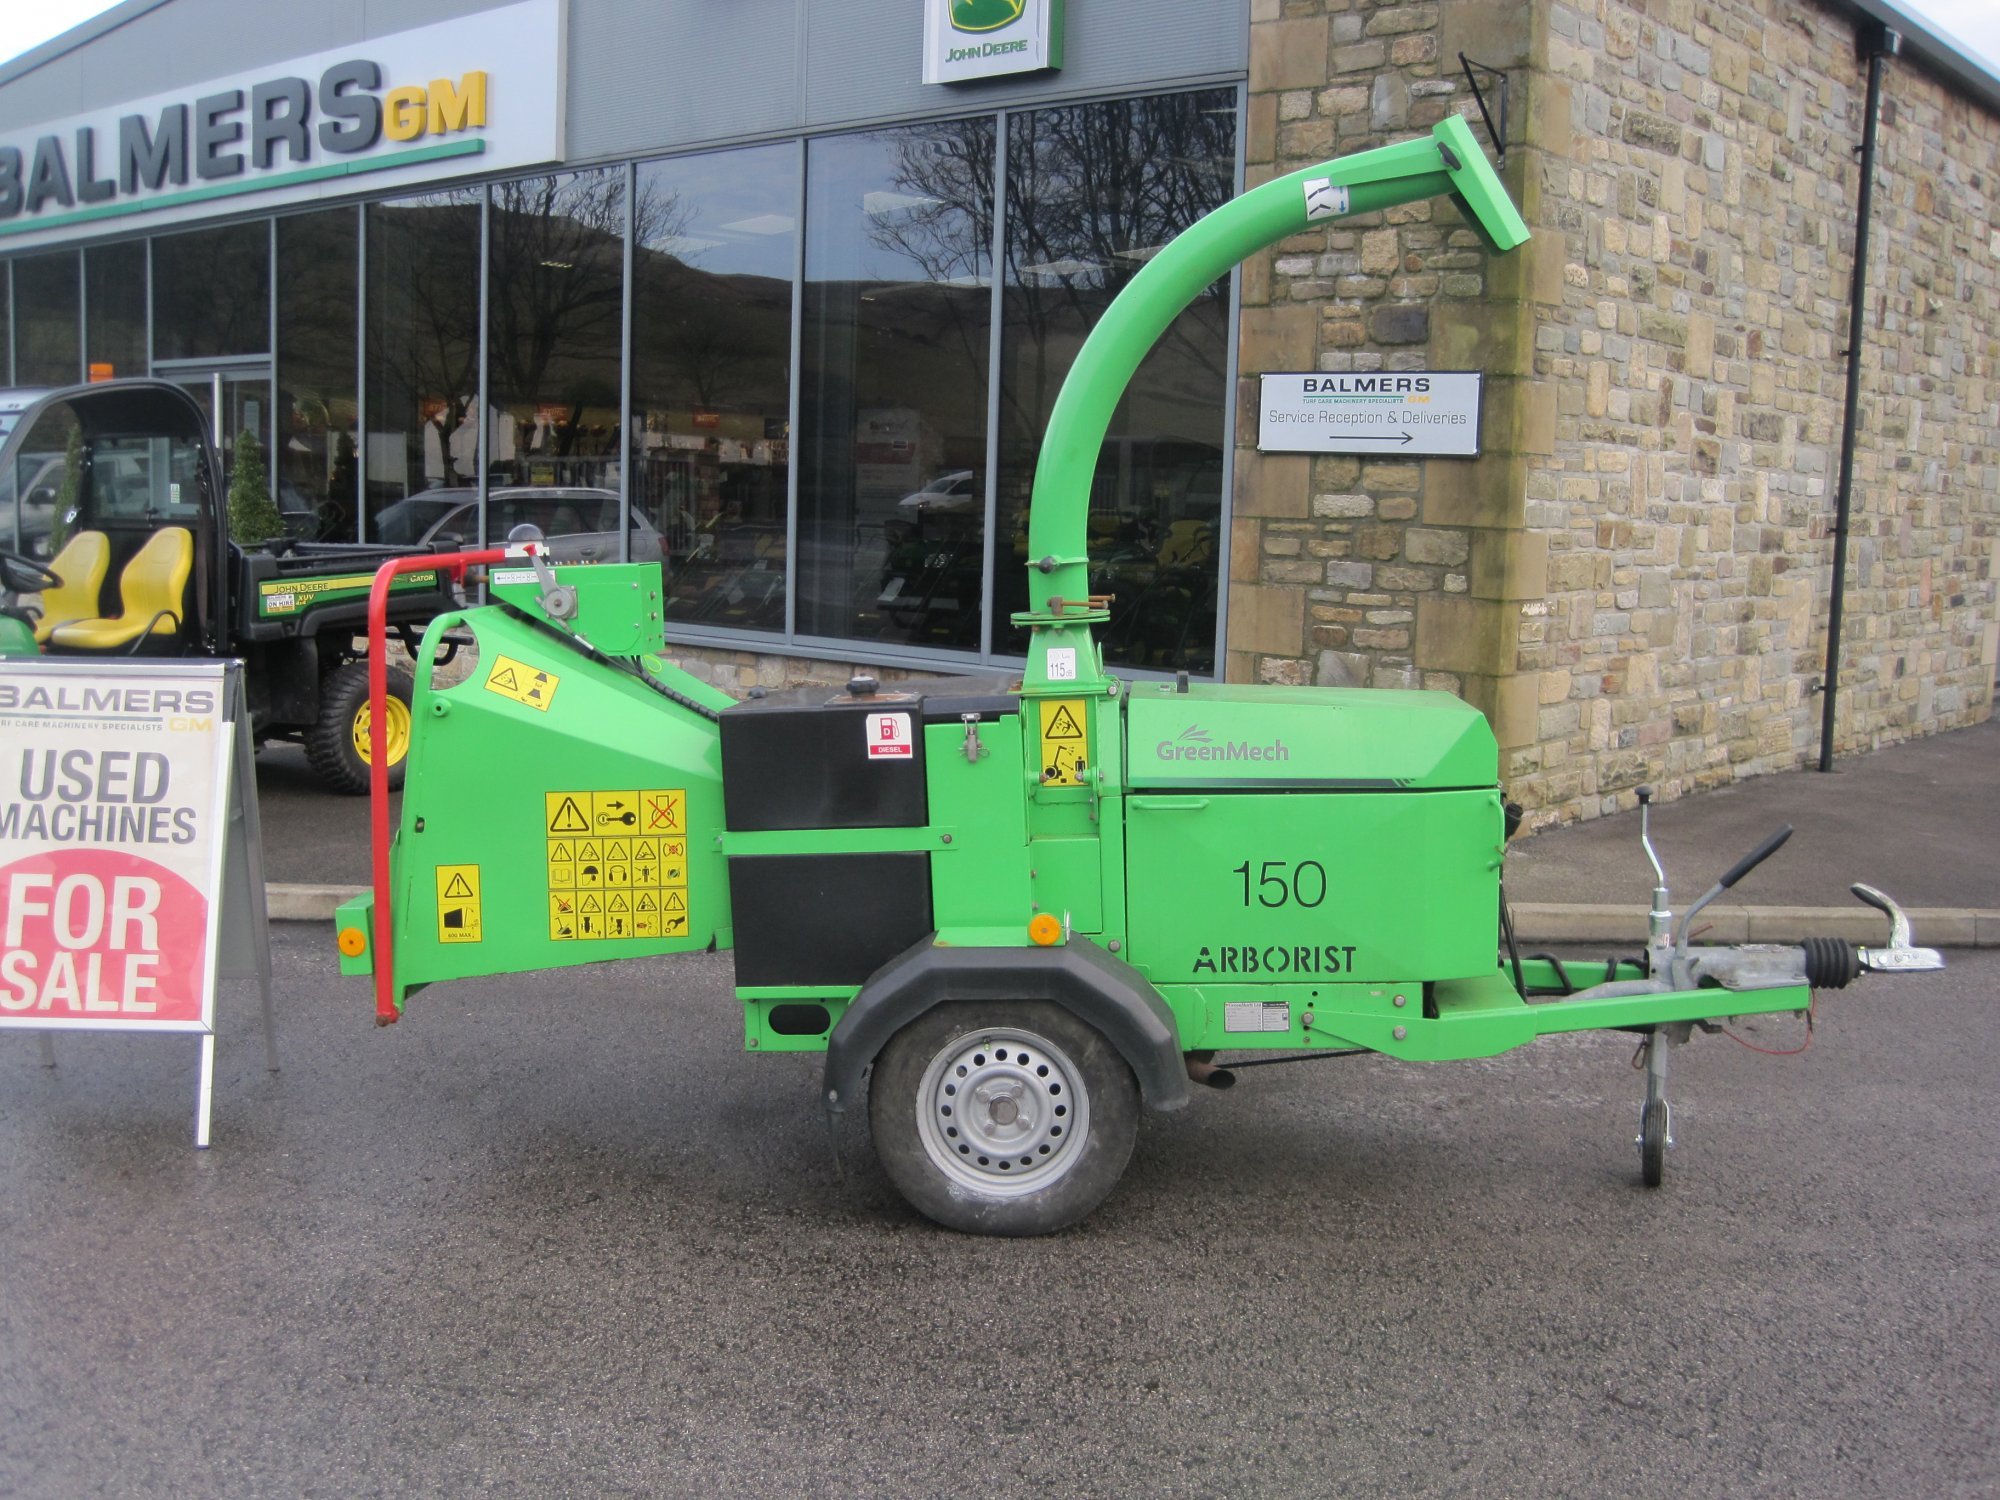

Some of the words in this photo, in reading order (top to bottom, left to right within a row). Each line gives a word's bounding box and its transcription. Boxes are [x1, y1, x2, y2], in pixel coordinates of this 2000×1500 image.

[945, 46, 982, 63] JOHN
[982, 39, 1028, 58] DEERE
[0, 59, 383, 219] BALMERS
[383, 71, 488, 143] GM
[1303, 377, 1431, 393] BALMERS
[1269, 410, 1315, 424] Service
[1319, 410, 1382, 427] Reception
[1387, 411, 1398, 424] &
[1402, 410, 1467, 425] Deliveries
[274, 585, 298, 594] JOHN
[300, 582, 329, 592] DEERE
[1050, 662, 1066, 678] 115
[0, 685, 214, 714] BALMERS
[15, 720, 40, 728] CARE
[42, 720, 99, 730] MACHINERY
[101, 722, 163, 732] SPECIALISTS
[1156, 739, 1289, 762] GreenMech
[20, 748, 171, 804] USED
[0, 803, 197, 845] MACHINES
[1232, 860, 1327, 909] 150
[5, 872, 162, 951] FOR
[1192, 946, 1357, 974] ARBORIST
[0, 949, 160, 1014] SALE
